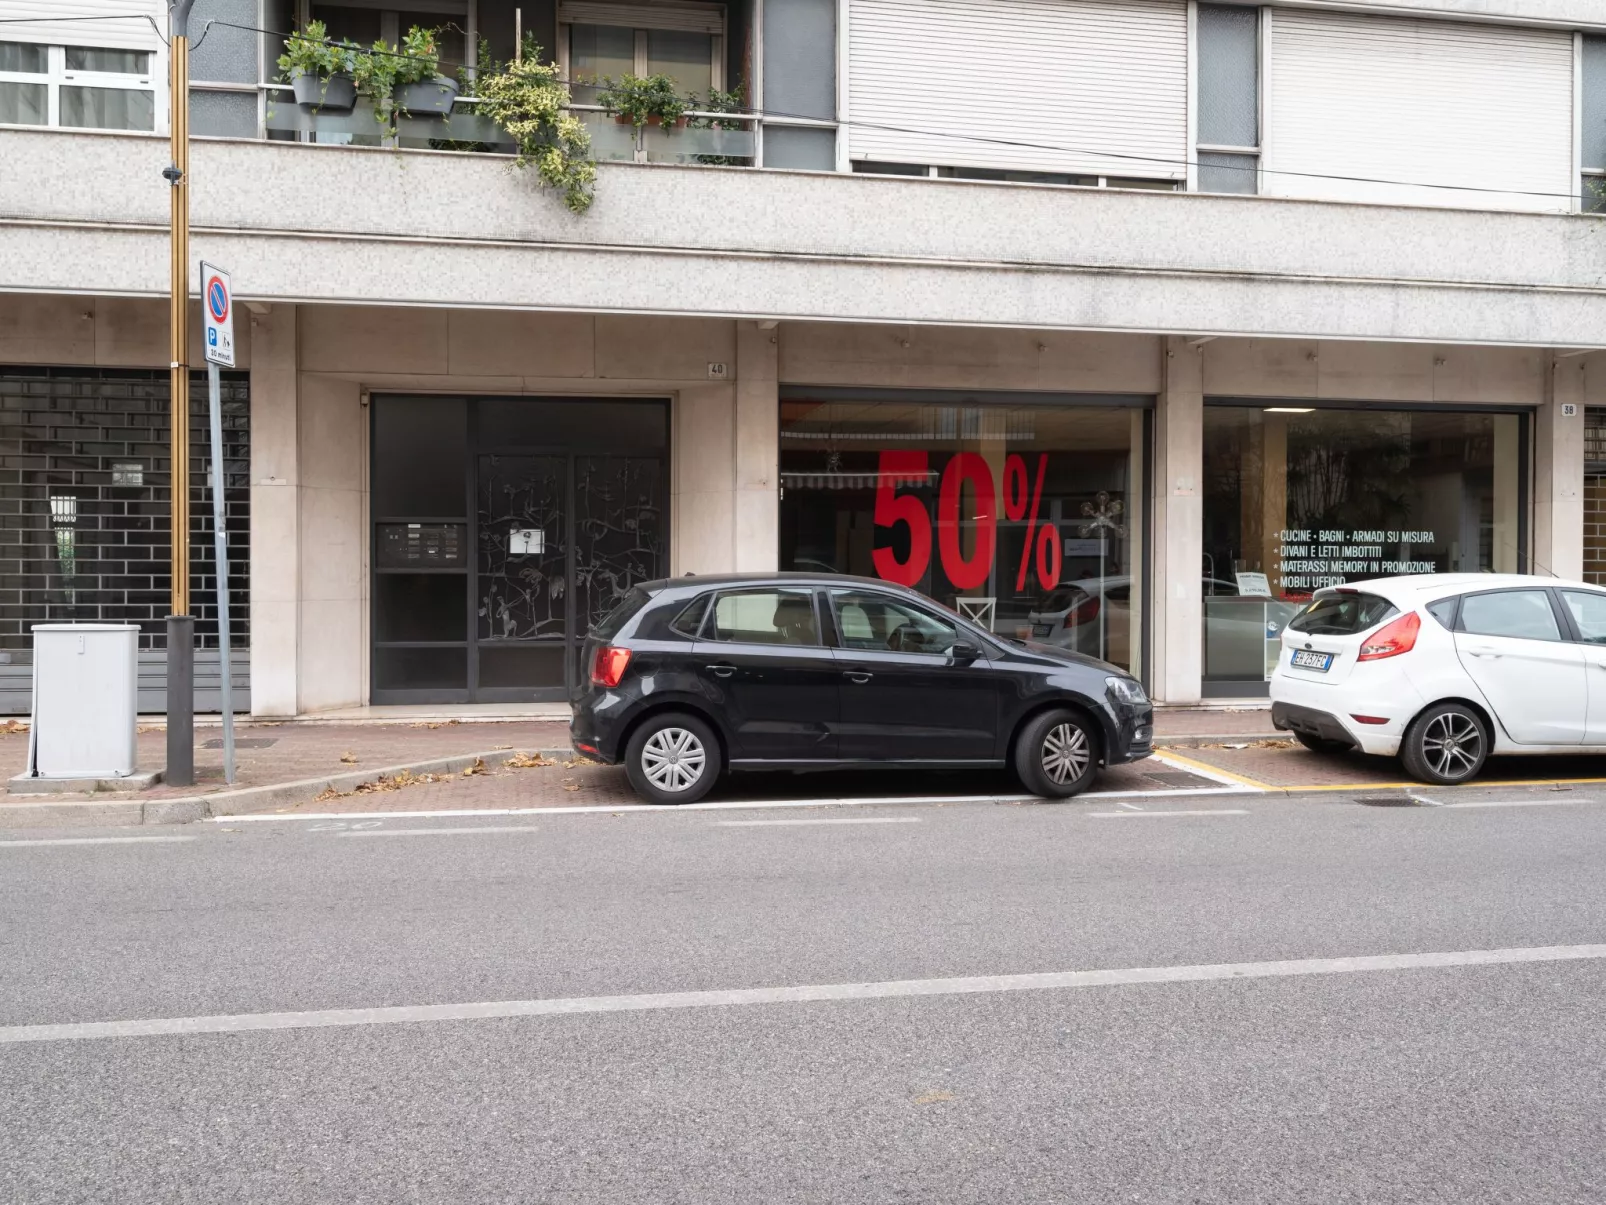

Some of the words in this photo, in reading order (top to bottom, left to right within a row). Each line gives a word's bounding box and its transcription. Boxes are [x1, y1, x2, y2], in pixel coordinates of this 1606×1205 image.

[711, 364, 723, 374] 40
[1564, 405, 1574, 415] 38
[872, 450, 1062, 592] 50%
[1280, 530, 1312, 542] CUCINE
[1319, 530, 1345, 543] BAGNI
[1352, 530, 1385, 543] ARMADI
[1387, 531, 1399, 543] SU
[1401, 531, 1435, 543] MISURA
[1280, 545, 1308, 557] DIVANI
[1311, 546, 1316, 557] E
[1318, 546, 1339, 558] LETTI
[1341, 546, 1382, 558] IMBOTTITI
[1280, 561, 1328, 572] MATERASSI
[1331, 561, 1368, 573] MEMORY
[1370, 561, 1379, 573] IN
[1382, 561, 1436, 573] PROMOZIONE
[1280, 576, 1310, 588] MOBILI
[1313, 576, 1346, 588] UFFICIO
